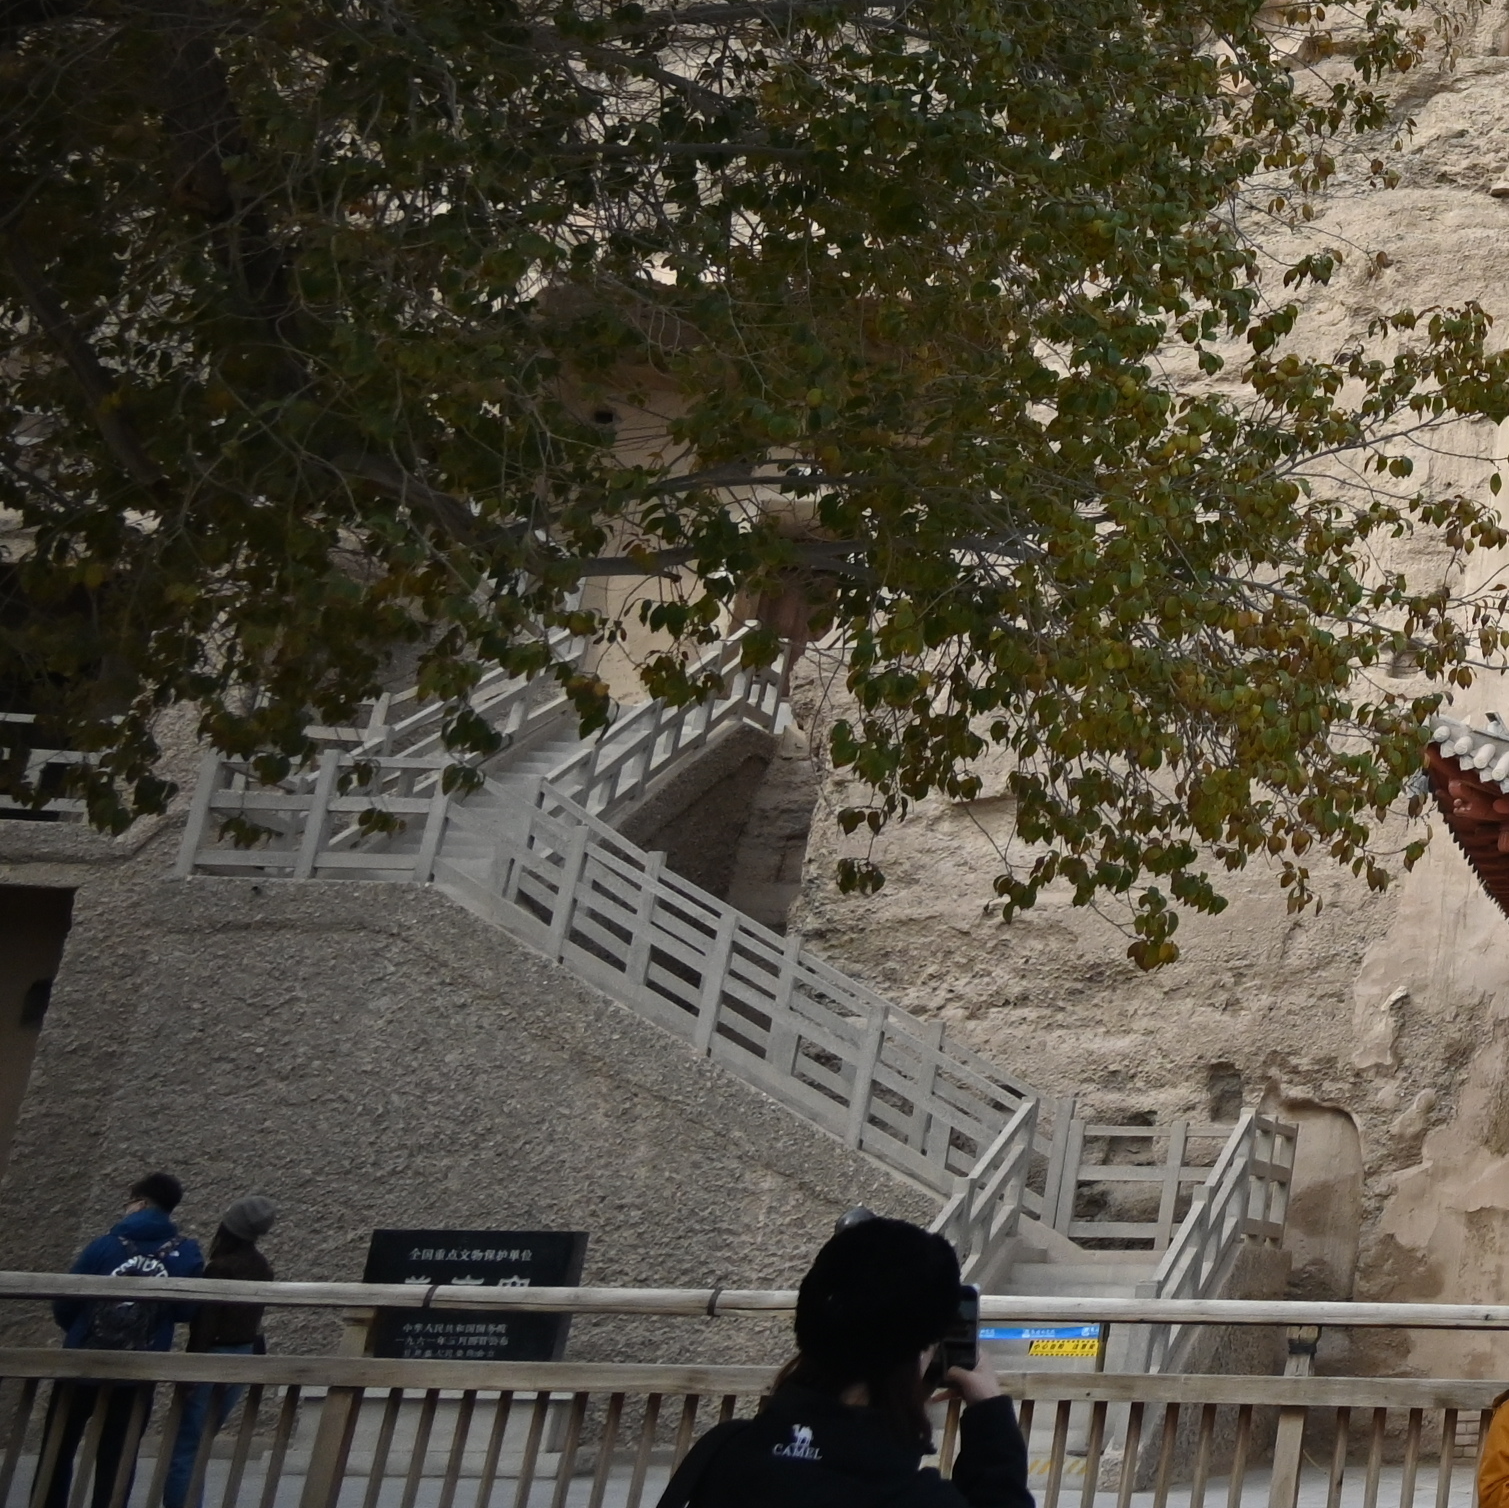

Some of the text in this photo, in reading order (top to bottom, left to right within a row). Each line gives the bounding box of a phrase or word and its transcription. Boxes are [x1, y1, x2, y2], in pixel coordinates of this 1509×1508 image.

[409, 1247, 532, 1261] 全国重点文物保护单位
[403, 1323, 507, 1334] 中华人民共和国国务院
[772, 1442, 823, 1461] CAMEL
